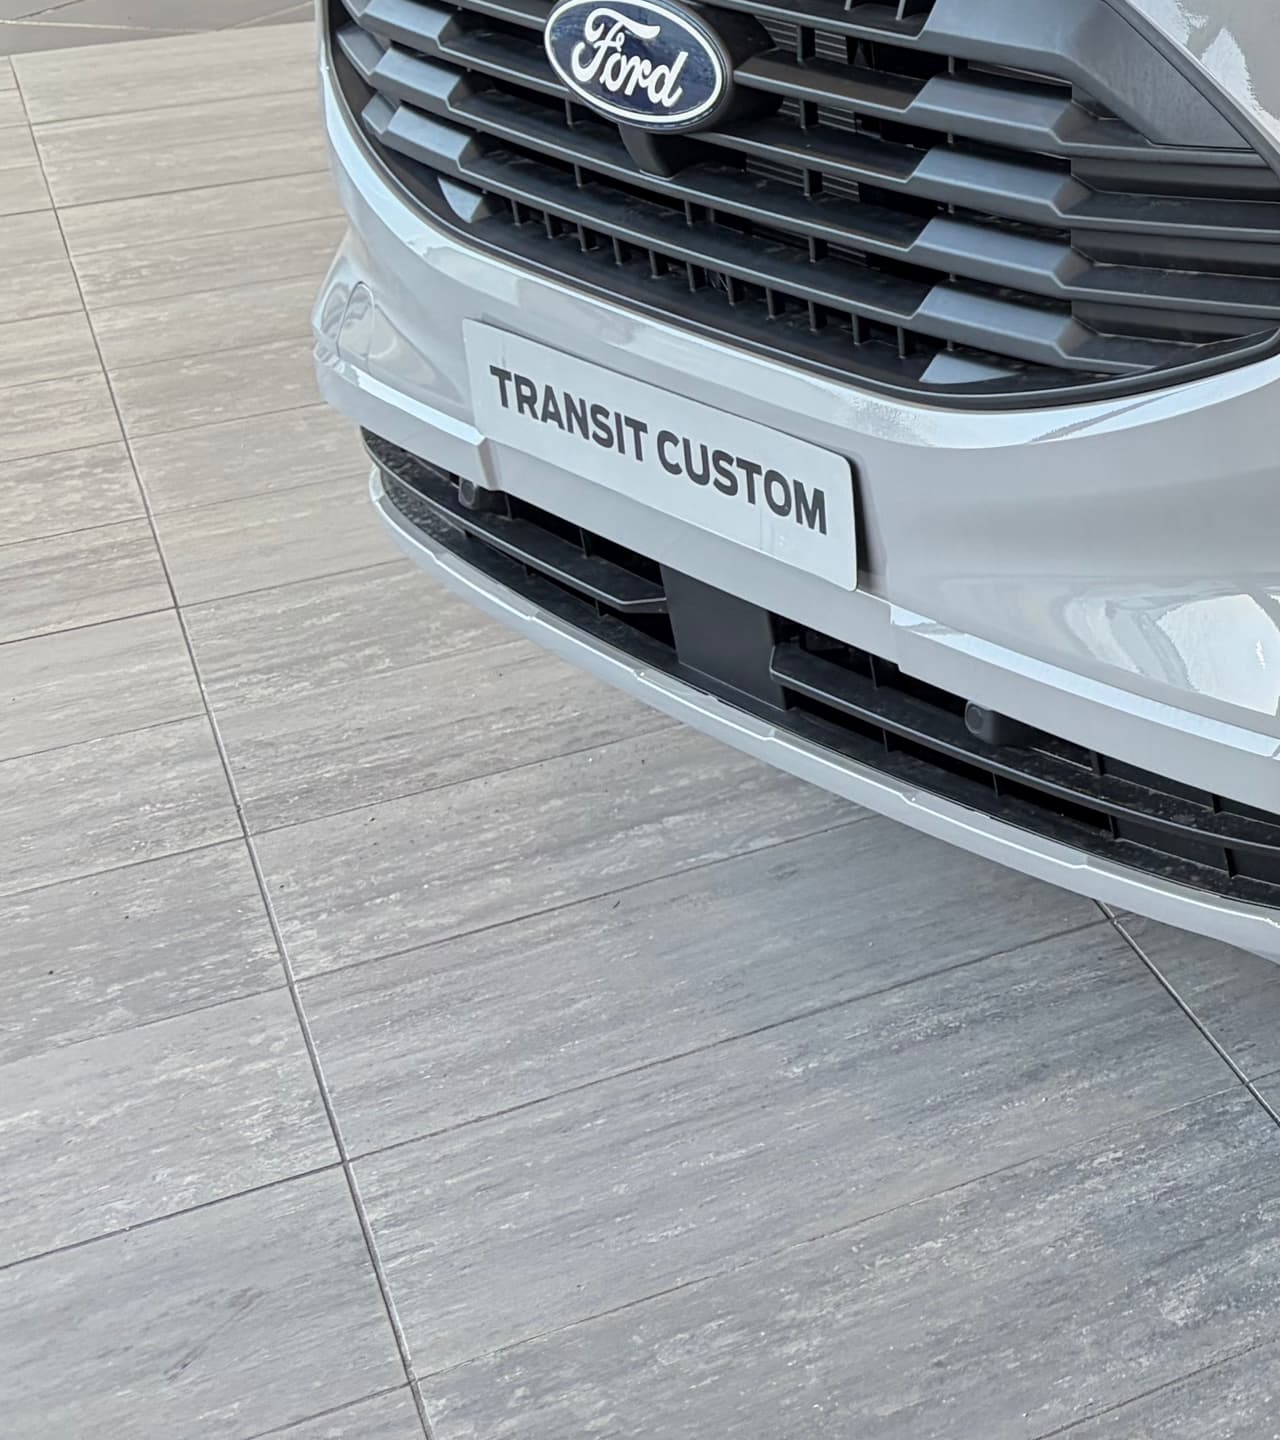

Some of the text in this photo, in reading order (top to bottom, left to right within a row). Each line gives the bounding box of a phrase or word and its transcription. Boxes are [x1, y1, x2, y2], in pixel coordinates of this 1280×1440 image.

[572, 7, 688, 108] Ford
[489, 365, 827, 536] TRANSIT CUSTOM
